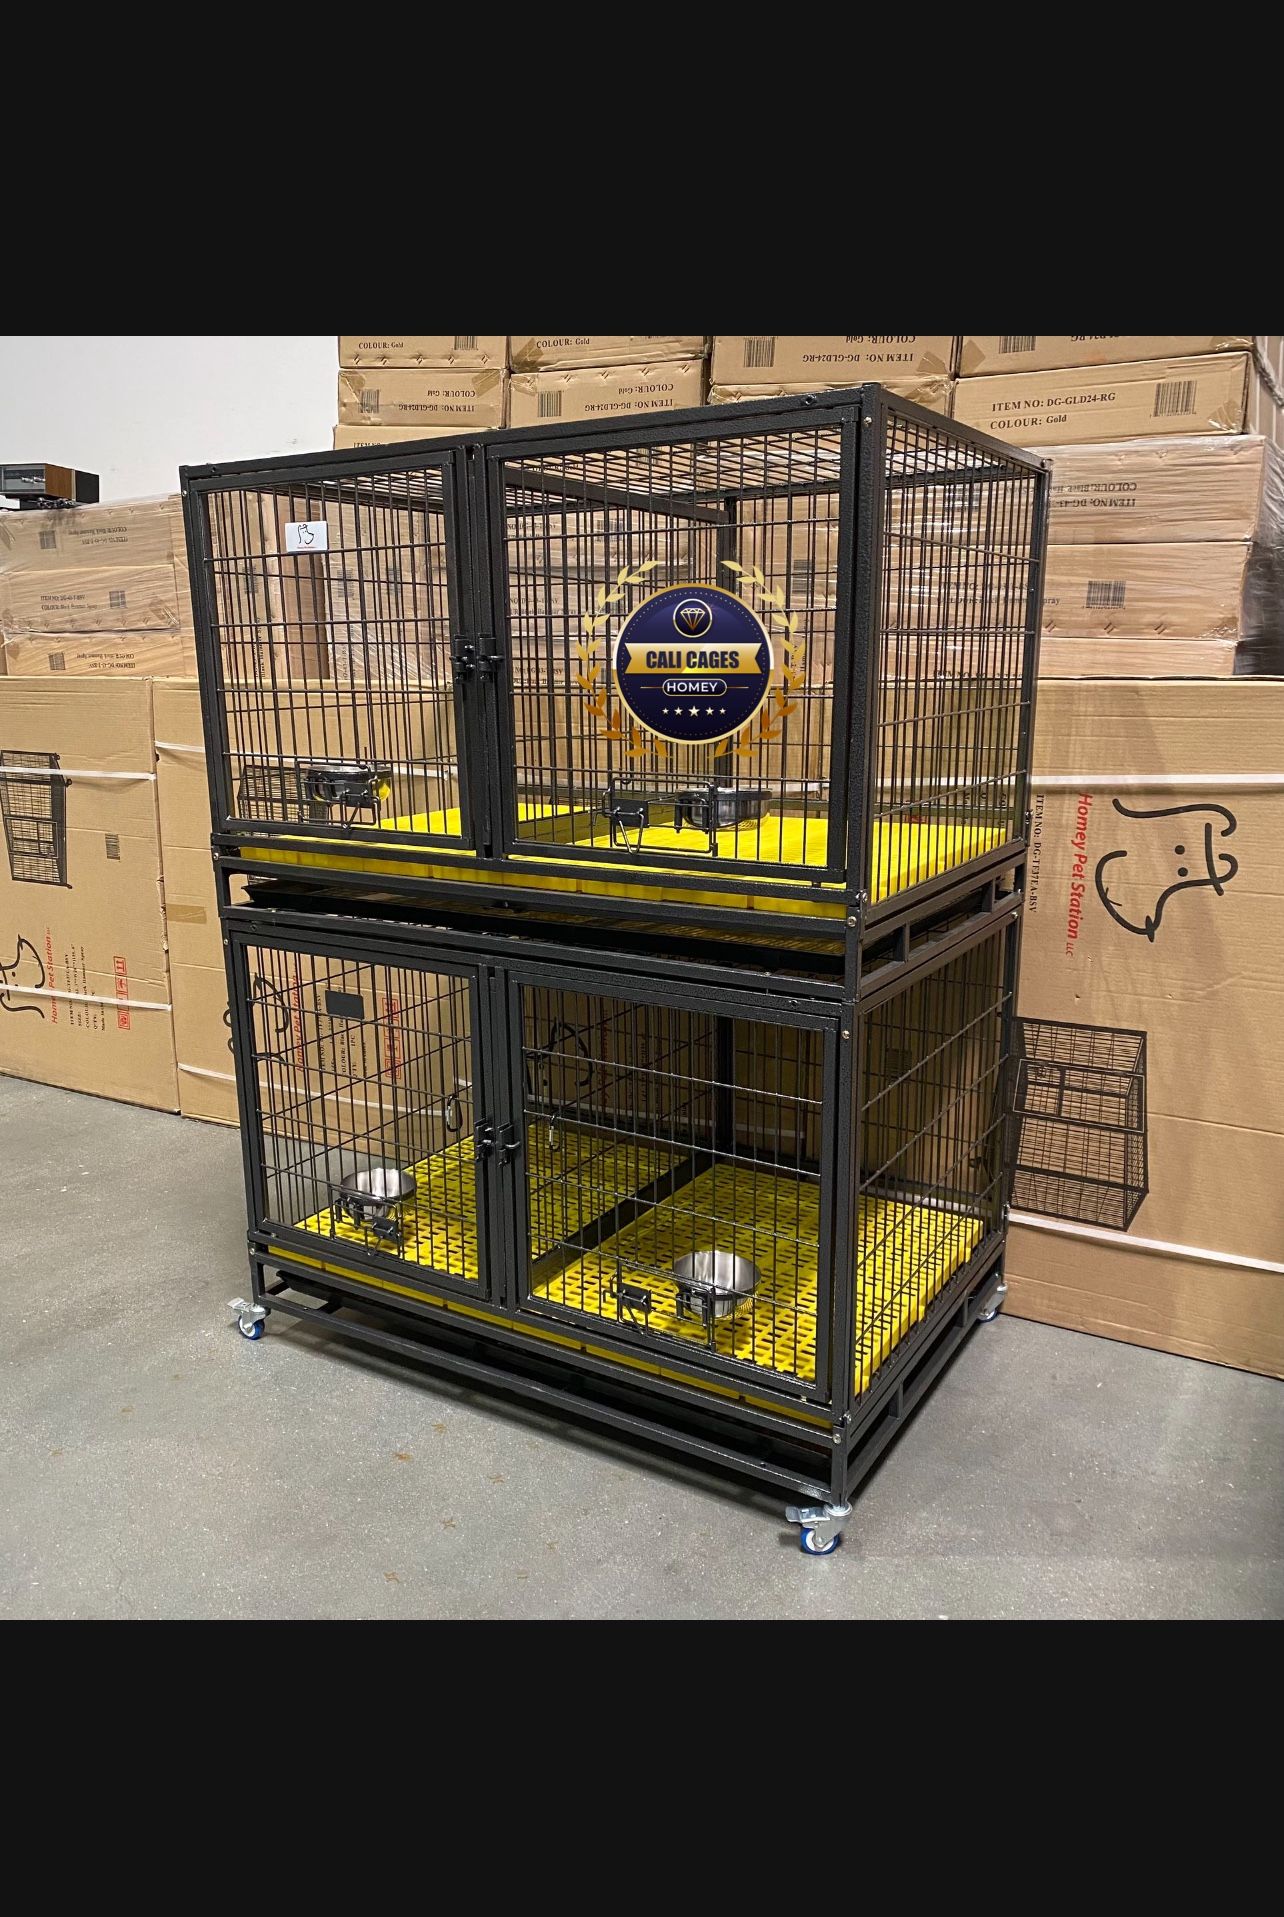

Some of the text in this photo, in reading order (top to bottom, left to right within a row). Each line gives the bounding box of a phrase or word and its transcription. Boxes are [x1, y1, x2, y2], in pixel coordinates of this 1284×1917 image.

[358, 341, 390, 349] COLOUR:
[536, 337, 591, 349] COLOUR: Gold
[845, 336, 916, 344] COLOUR: Gold
[802, 353, 913, 363] ITEM NO: DG-GLD24-RG
[618, 383, 674, 395] COLOUR: Gold
[455, 404, 475, 412] ITEM
[584, 398, 673, 412] ITEM NO: DG-GLD24-RG
[992, 392, 1116, 412] ITEM NO: DG-GLD24-RG
[990, 414, 1067, 430] COLOUR: Gold
[1090, 482, 1137, 492] COLOUR:
[1090, 498, 1108, 507] NO:
[1108, 498, 1136, 507] ITEM
[1028, 794, 1044, 913] ITEM NO: DG-TF37EA-BSV
[1065, 793, 1093, 957] Homey Pet Station LLC
[45, 936, 54, 971] Station
[50, 996, 58, 1024] Home
[293, 1014, 302, 1033] Pet
